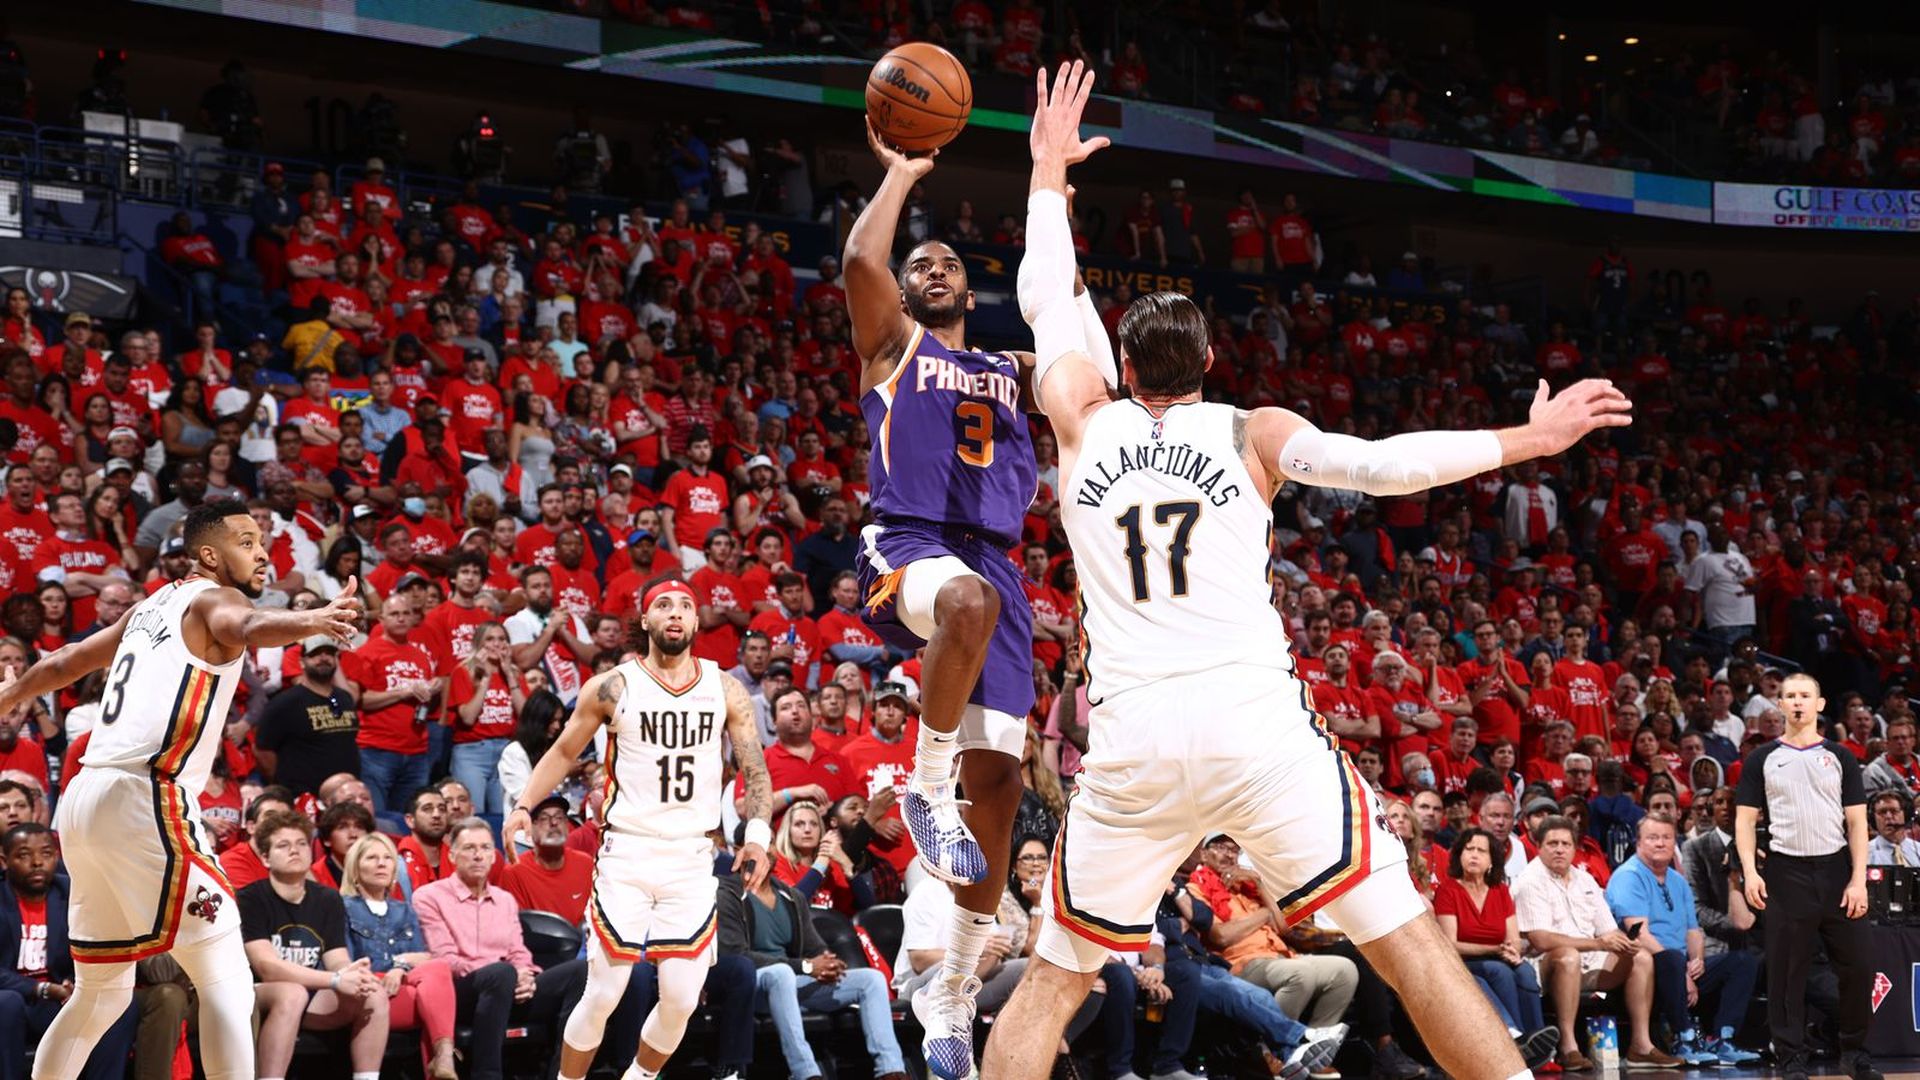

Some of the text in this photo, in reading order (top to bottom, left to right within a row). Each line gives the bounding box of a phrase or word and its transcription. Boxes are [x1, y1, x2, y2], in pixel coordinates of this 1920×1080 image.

[1774, 187, 1845, 212] GULF
[956, 401, 994, 468] 3
[1077, 441, 1241, 508] VALANČIŪNAS
[1114, 499, 1203, 604] 17
[102, 653, 135, 726] 3
[639, 711, 715, 750] NOLA
[656, 755, 695, 803] 15
